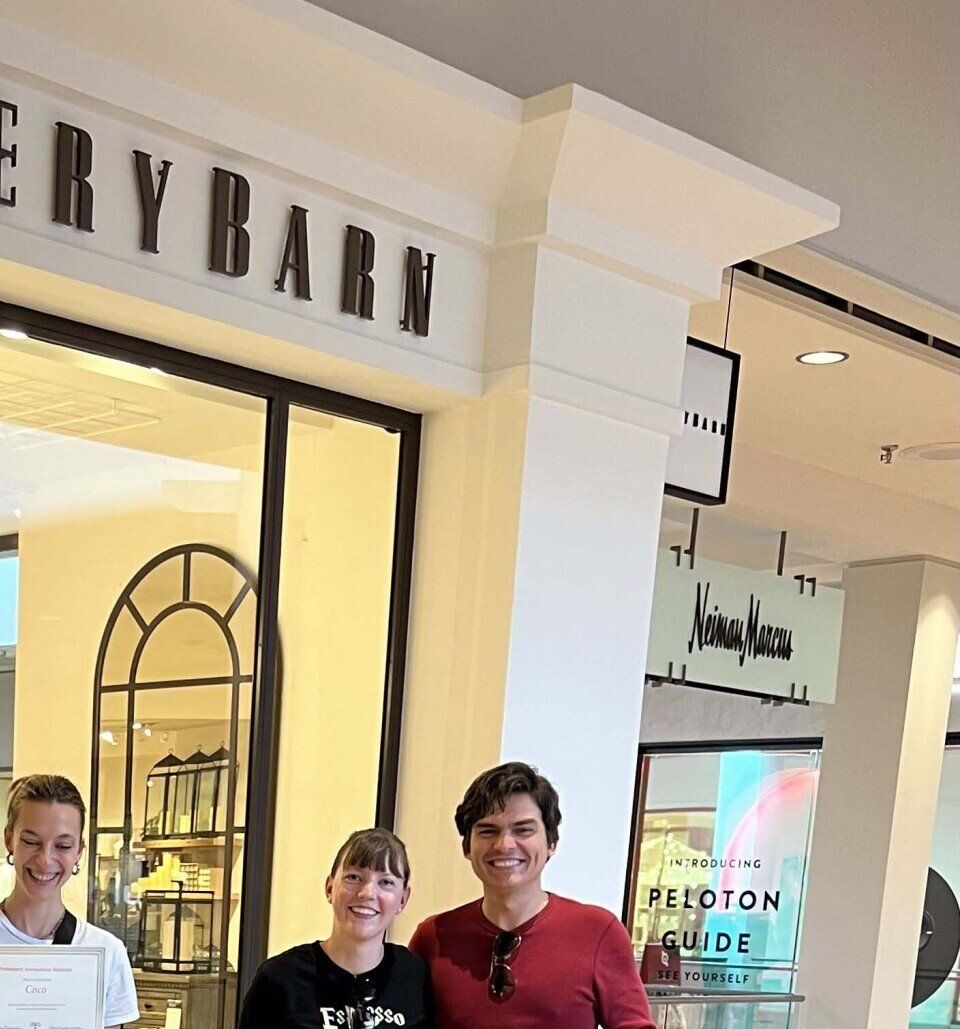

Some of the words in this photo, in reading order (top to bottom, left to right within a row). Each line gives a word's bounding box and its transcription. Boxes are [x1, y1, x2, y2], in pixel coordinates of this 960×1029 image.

[688, 581, 744, 653] Neiman
[739, 593, 794, 667] Marcus
[669, 858, 762, 869] INTRODUCING
[648, 887, 781, 911] PELOTON
[661, 930, 752, 954] GUIDE
[657, 969, 680, 981] SEE
[684, 970, 750, 985] YOURSELF
